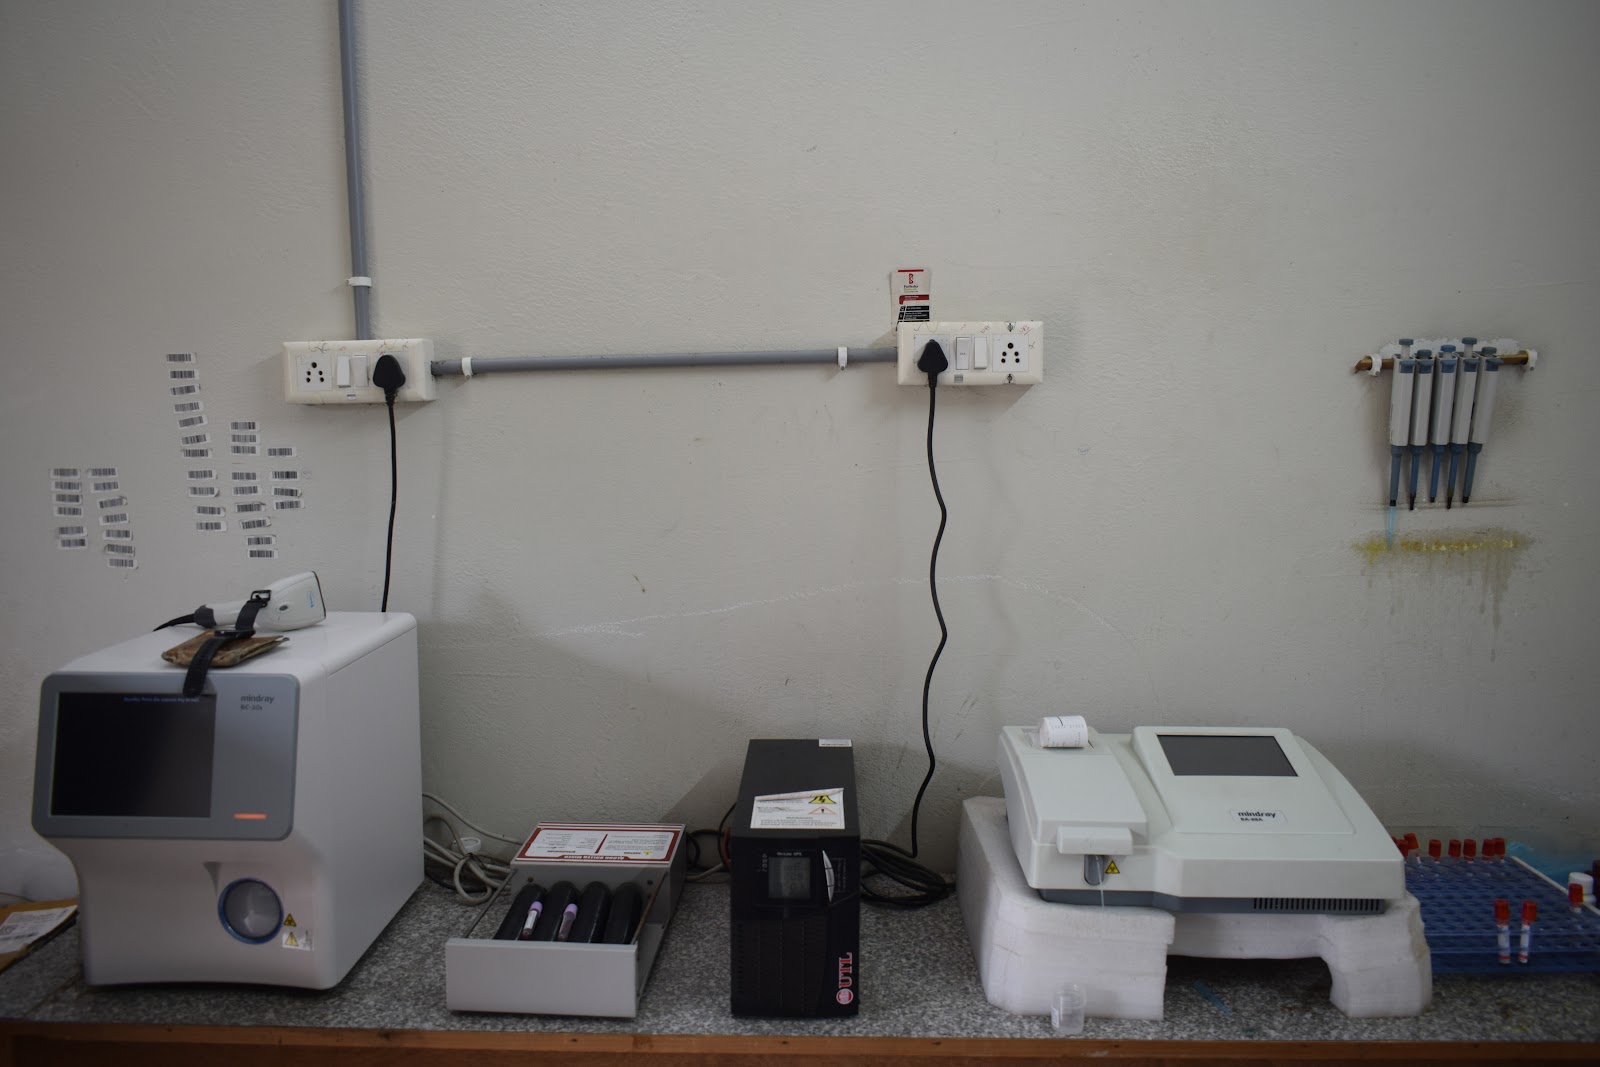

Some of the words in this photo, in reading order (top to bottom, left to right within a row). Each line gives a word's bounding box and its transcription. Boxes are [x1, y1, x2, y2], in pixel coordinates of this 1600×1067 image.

[240, 695, 274, 706] mindray
[1238, 811, 1276, 819] mindray
[838, 952, 853, 989] UTL
